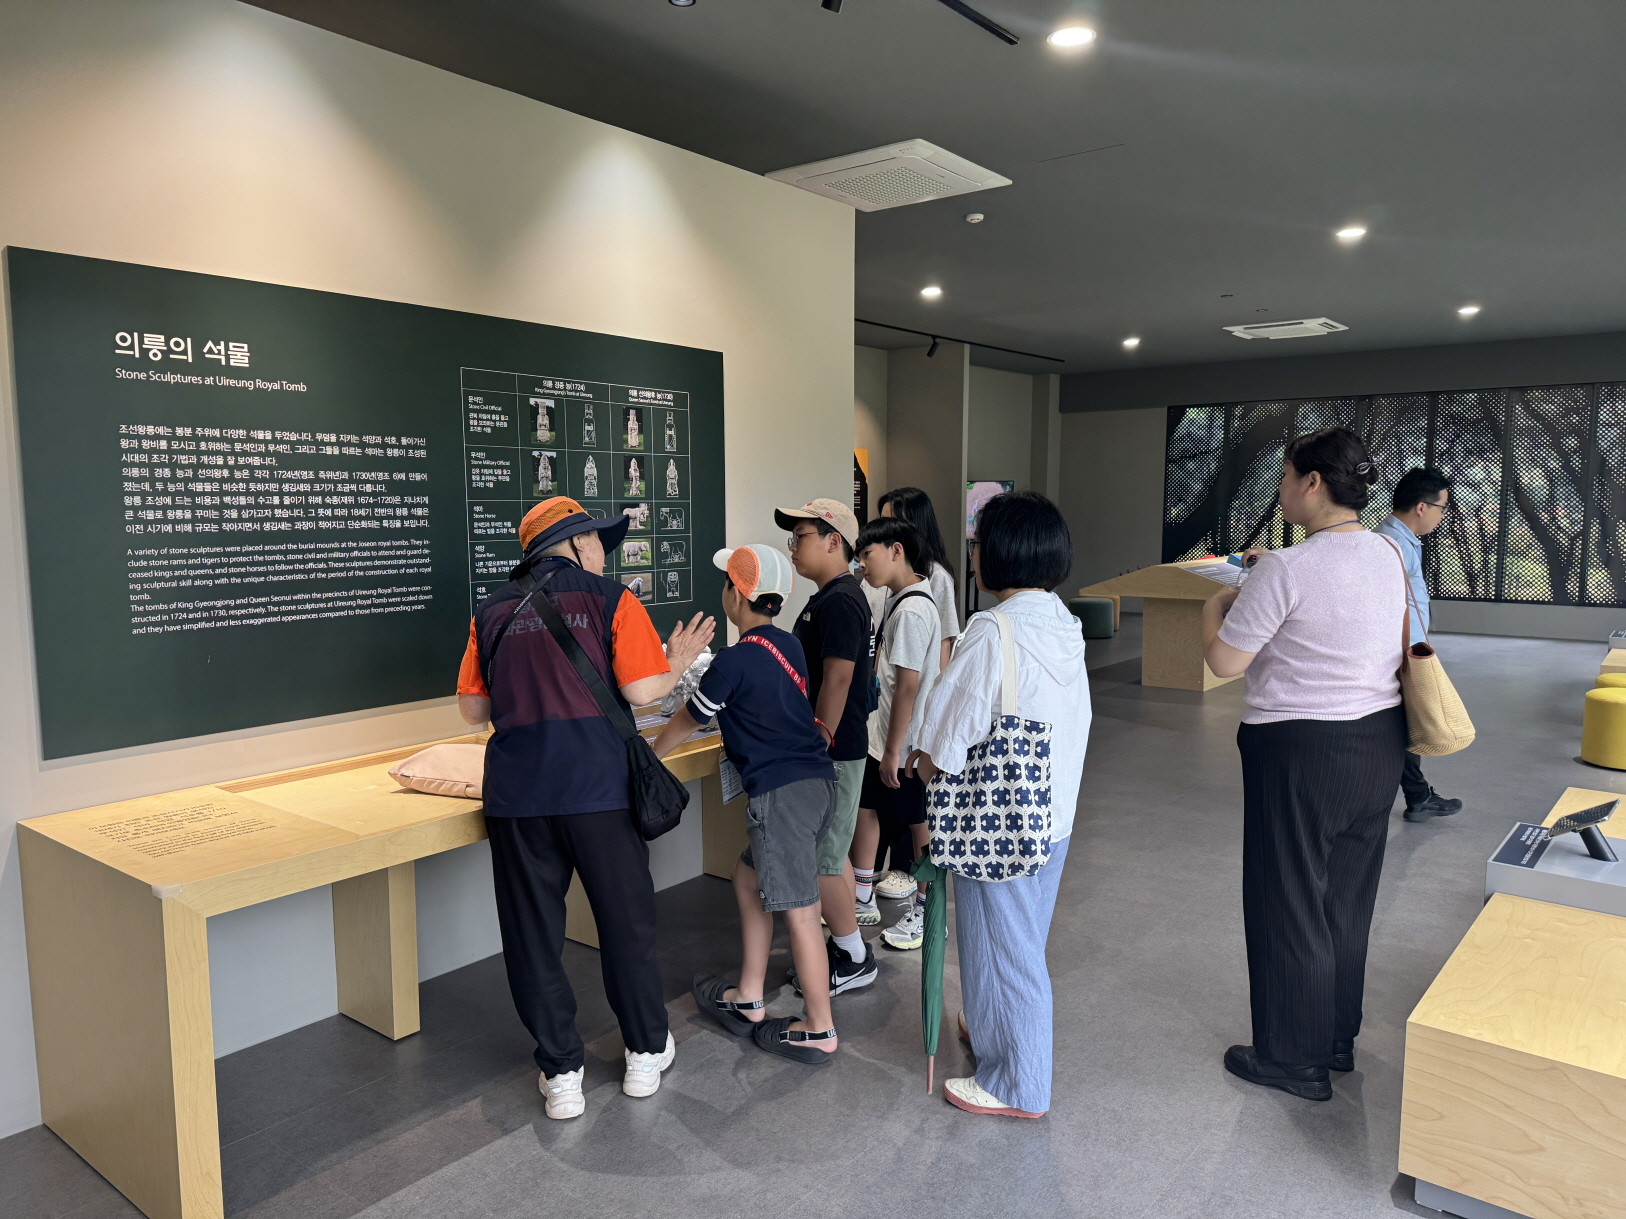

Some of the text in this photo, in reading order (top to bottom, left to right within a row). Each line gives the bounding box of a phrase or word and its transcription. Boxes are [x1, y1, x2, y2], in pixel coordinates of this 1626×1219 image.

[115, 332, 250, 367] 의릉의 석물
[115, 368, 307, 392] Stone Sculptures at Uireung Royal Tomb
[119, 425, 172, 435] 조선왕릉에는
[175, 427, 192, 436] 봉분
[195, 428, 220, 437] 주위에
[223, 429, 247, 438] 다양한
[249, 430, 272, 440] 석물을
[275, 431, 313, 441] 두었습니다.
[316, 433, 337, 442] 무덤을
[339, 434, 359, 443] 지키는
[362, 435, 382, 444] 석양과
[401, 437, 425, 445] 돌아가신
[120, 439, 139, 448] 왕과
[141, 439, 168, 449] 왕비를
[171, 441, 197, 450] 모시고
[199, 442, 232, 451] 호위하는
[234, 443, 266, 452] 문석인과
[294, 445, 316, 454] 그리고
[319, 446, 340, 454] 그들을
[342, 447, 362, 455] 따르는
[364, 448, 384, 456] 석마는
[386, 448, 405, 456] 왕릉이
[121, 453, 278, 466] 시대의 조각 기법과 개성을 잘 보여줍니다.
[122, 468, 149, 477] 의릉의
[154, 468, 171, 478] 경종
[176, 468, 193, 478] 능과
[197, 469, 230, 478] 선의왕후
[234, 469, 250, 478] 능은
[254, 470, 270, 478] 각각
[123, 482, 387, 492] 졌는데, 두 능의 석물들은 비슷한 듯하지만 생김새와 크기가 조금씩 다릅니다.
[124, 496, 142, 506] 왕릉
[145, 496, 172, 505] 조성에
[175, 496, 192, 505] 드는
[195, 496, 220, 505] 비용과
[223, 496, 254, 505] 백성들의
[257, 496, 280, 504] 수고를
[283, 496, 305, 504] 줄이기
[308, 496, 322, 504] 위해
[324, 496, 354, 504] 숙종(재위
[124, 510, 134, 520] 큰
[137, 510, 164, 519] 석물로
[166, 510, 192, 519] 왕릉을
[195, 509, 220, 519] 꾸미는
[222, 509, 238, 518] 것을
[274, 508, 305, 517] 했습니다.
[317, 508, 332, 517] 뜻에
[351, 508, 372, 516] 18세기
[374, 508, 393, 516] 전반의
[395, 508, 408, 516] 왕릉
[126, 524, 144, 534] 이전
[146, 524, 172, 533] 시기에
[175, 523, 192, 533] 비해
[194, 523, 219, 532] 규모는
[222, 522, 260, 531] 작아지면서
[262, 522, 292, 531] 생김새는
[294, 521, 316, 530] 과장이
[318, 521, 345, 529] 적어지고
[347, 520, 380, 528] 단순화되는
[190, 546, 224, 554] sculptures
[242, 544, 263, 552] placed
[143, 580, 177, 589] sculptural
[761, 639, 795, 674] ICEBISCUIT
